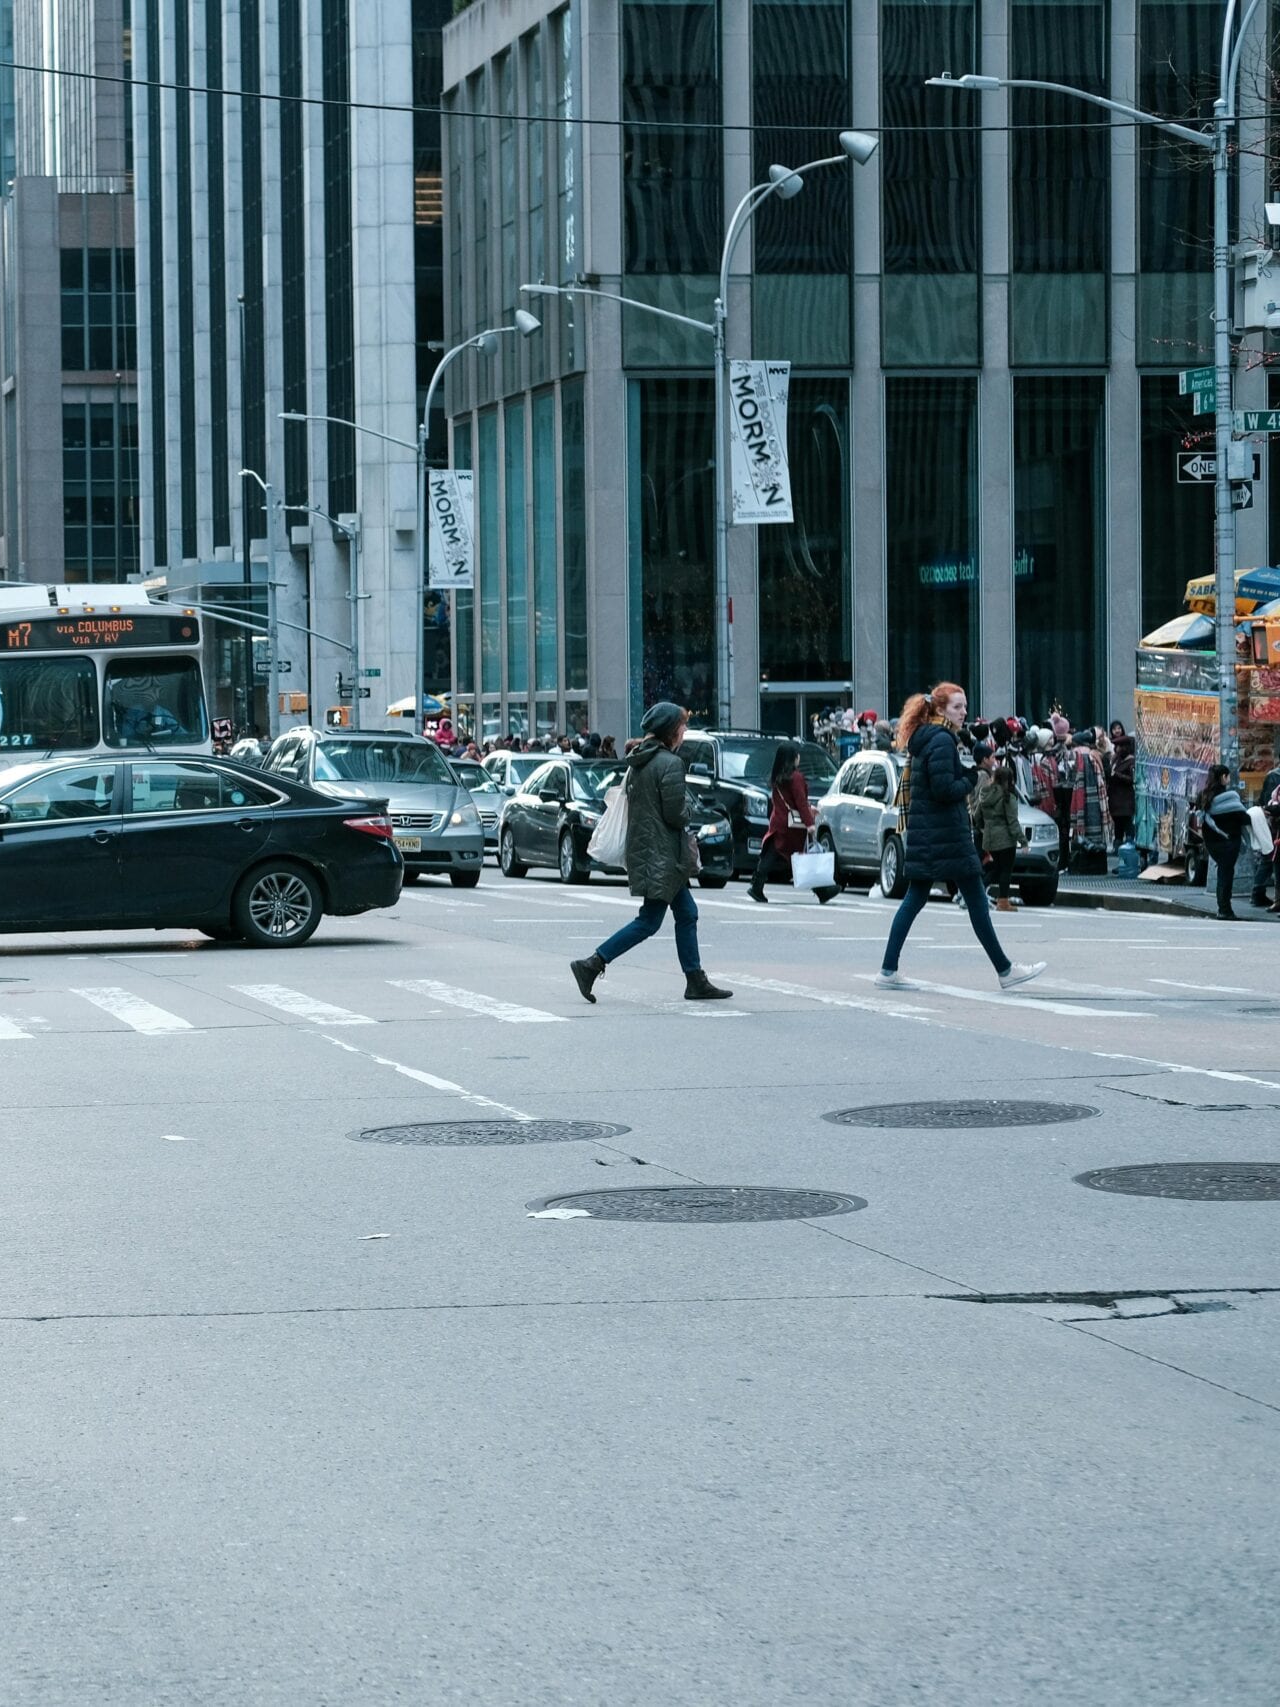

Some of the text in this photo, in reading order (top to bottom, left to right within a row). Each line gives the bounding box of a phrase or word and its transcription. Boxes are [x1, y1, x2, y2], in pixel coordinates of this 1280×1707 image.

[769, 367, 788, 375] NYC
[1247, 413, 1260, 430] W
[1190, 462, 1215, 473] ONE
[7, 619, 134, 647] M7 VIA COLUMBUS
[72, 632, 119, 645] VIA 7 AV
[0, 733, 33, 747] 227
